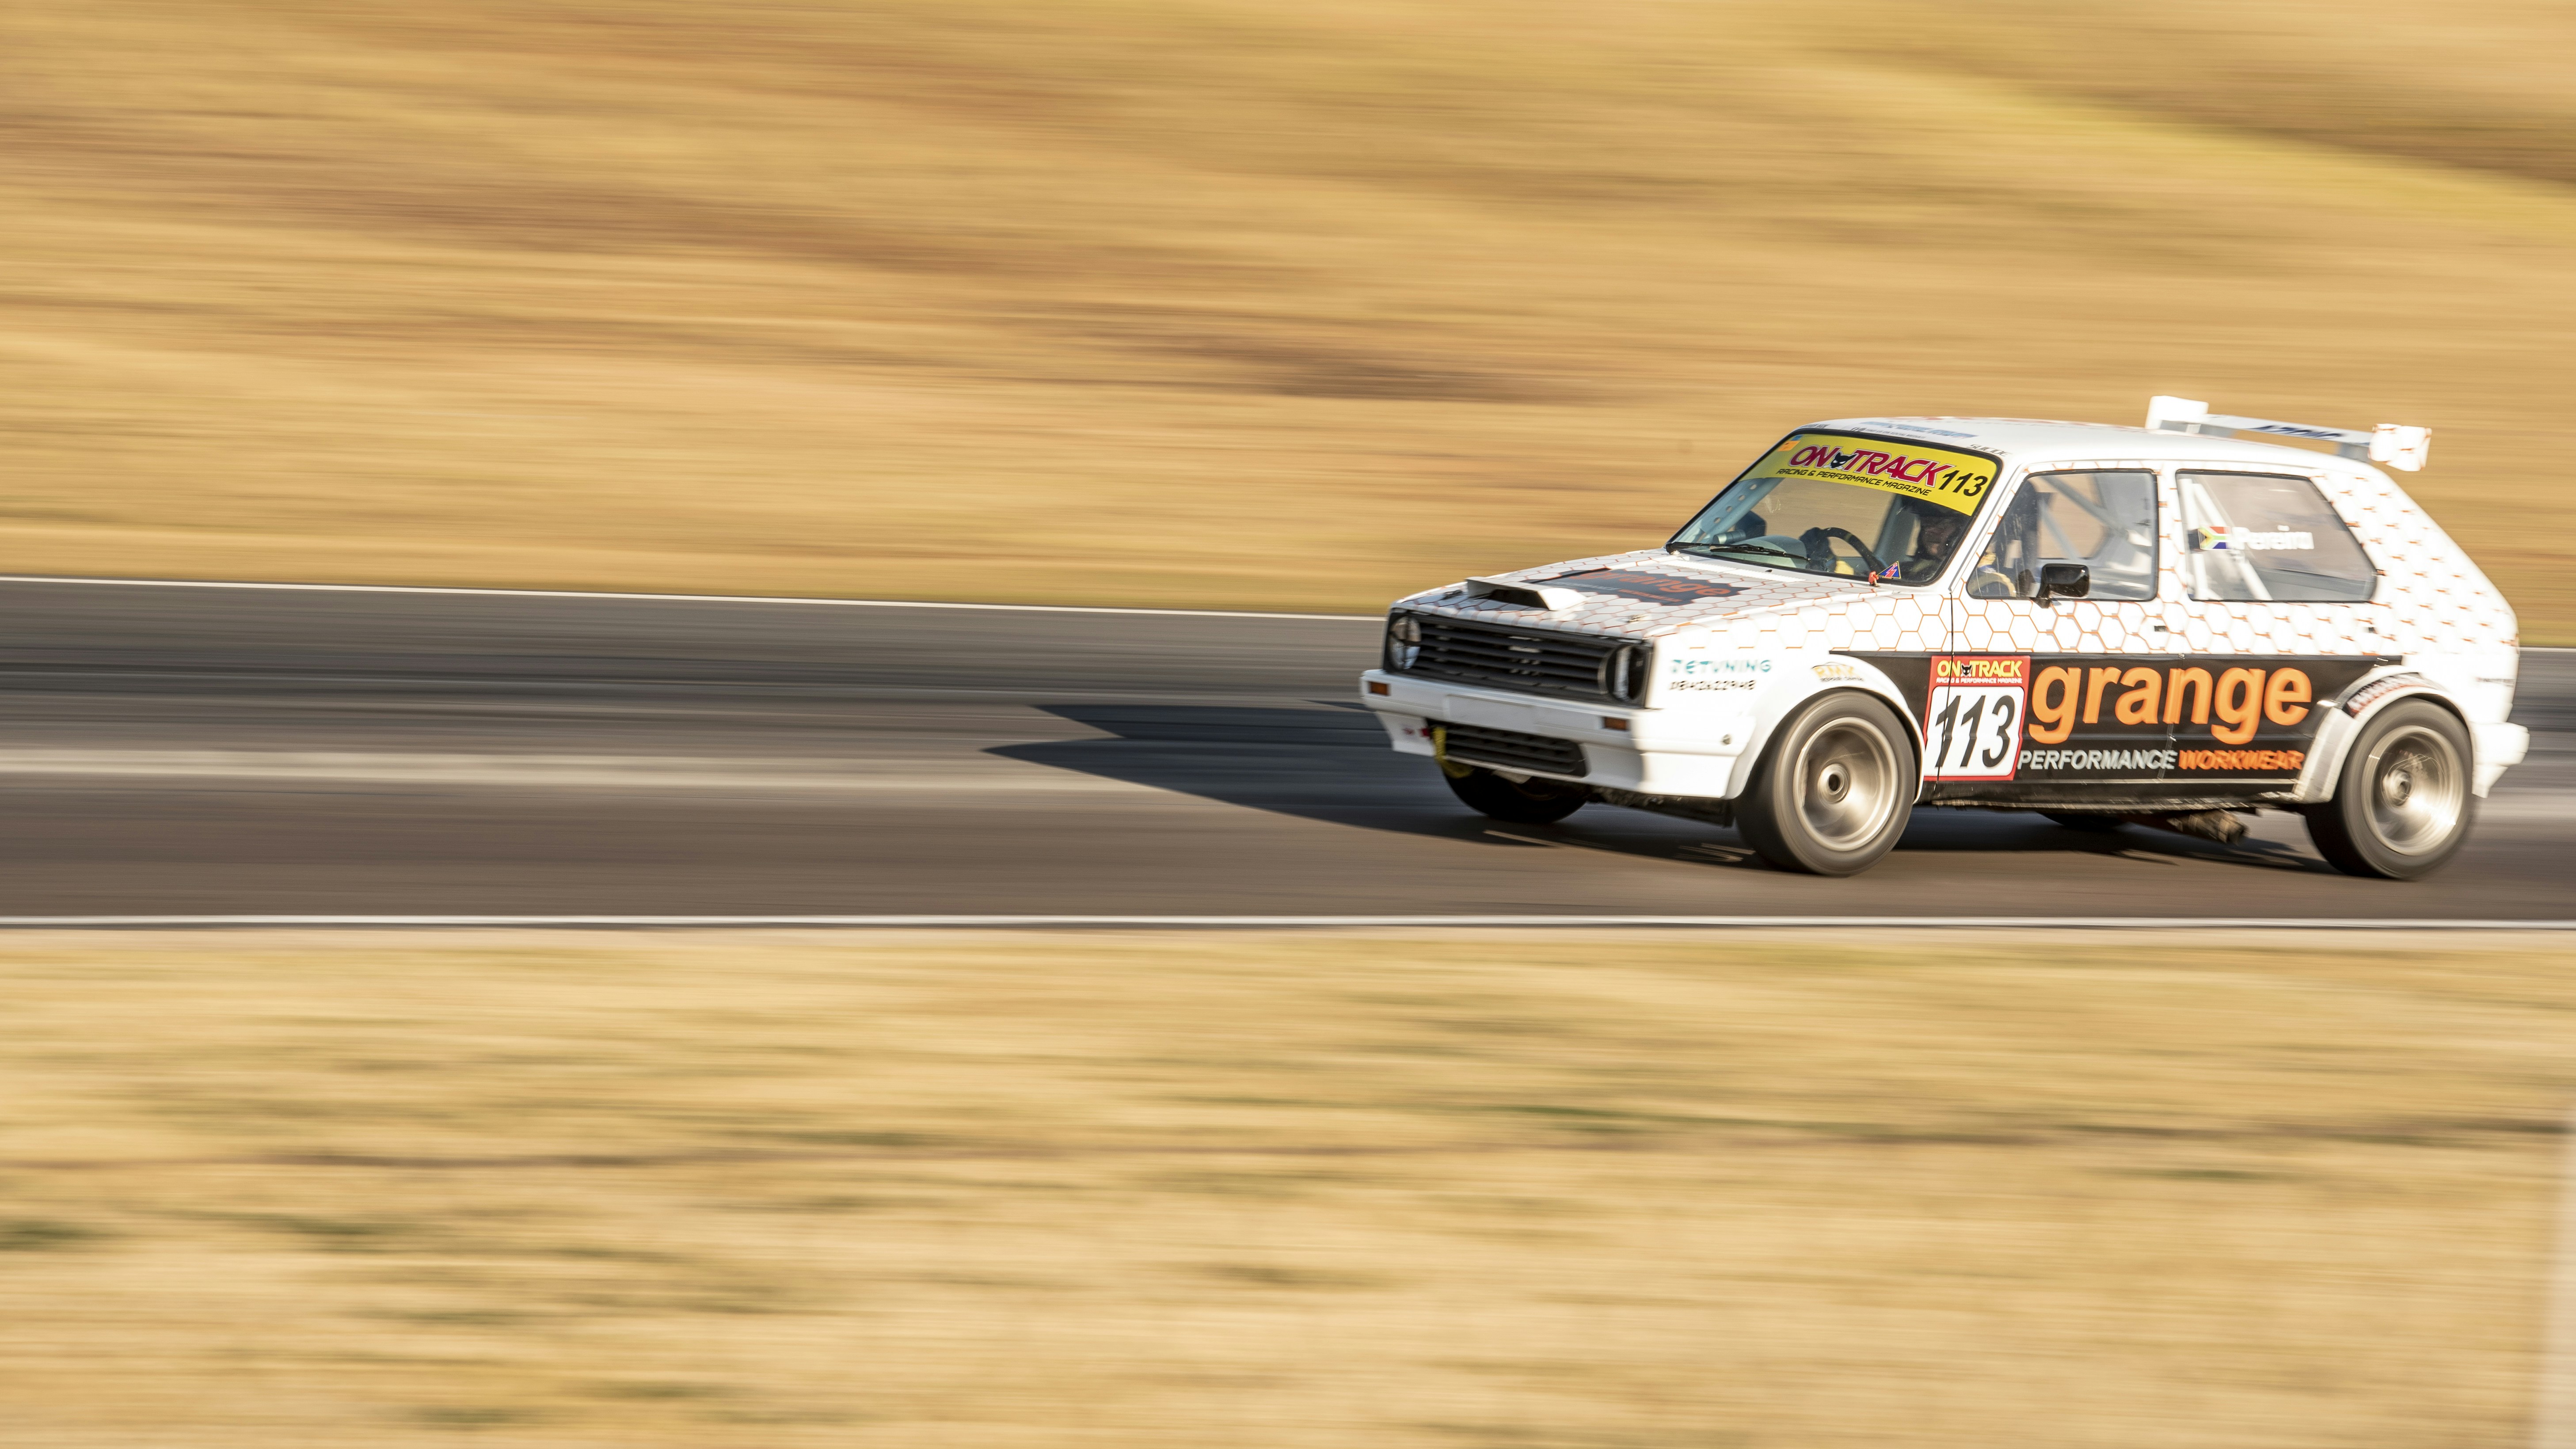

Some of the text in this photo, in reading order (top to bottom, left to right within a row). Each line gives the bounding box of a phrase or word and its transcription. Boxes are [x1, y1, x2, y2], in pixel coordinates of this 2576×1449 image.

[1788, 445, 1956, 488] ON TRACK
[1816, 471, 1883, 486] PERFORMANCE
[1881, 481, 1932, 496] MAGAZINE
[1938, 470, 1988, 497] 113
[1569, 571, 1731, 596] grange
[1937, 660, 2023, 677] ON TRACK
[2028, 666, 2312, 745] grange
[1934, 694, 2016, 769] 113
[2017, 749, 2305, 770] PERFORMANCE WORKWEAR
